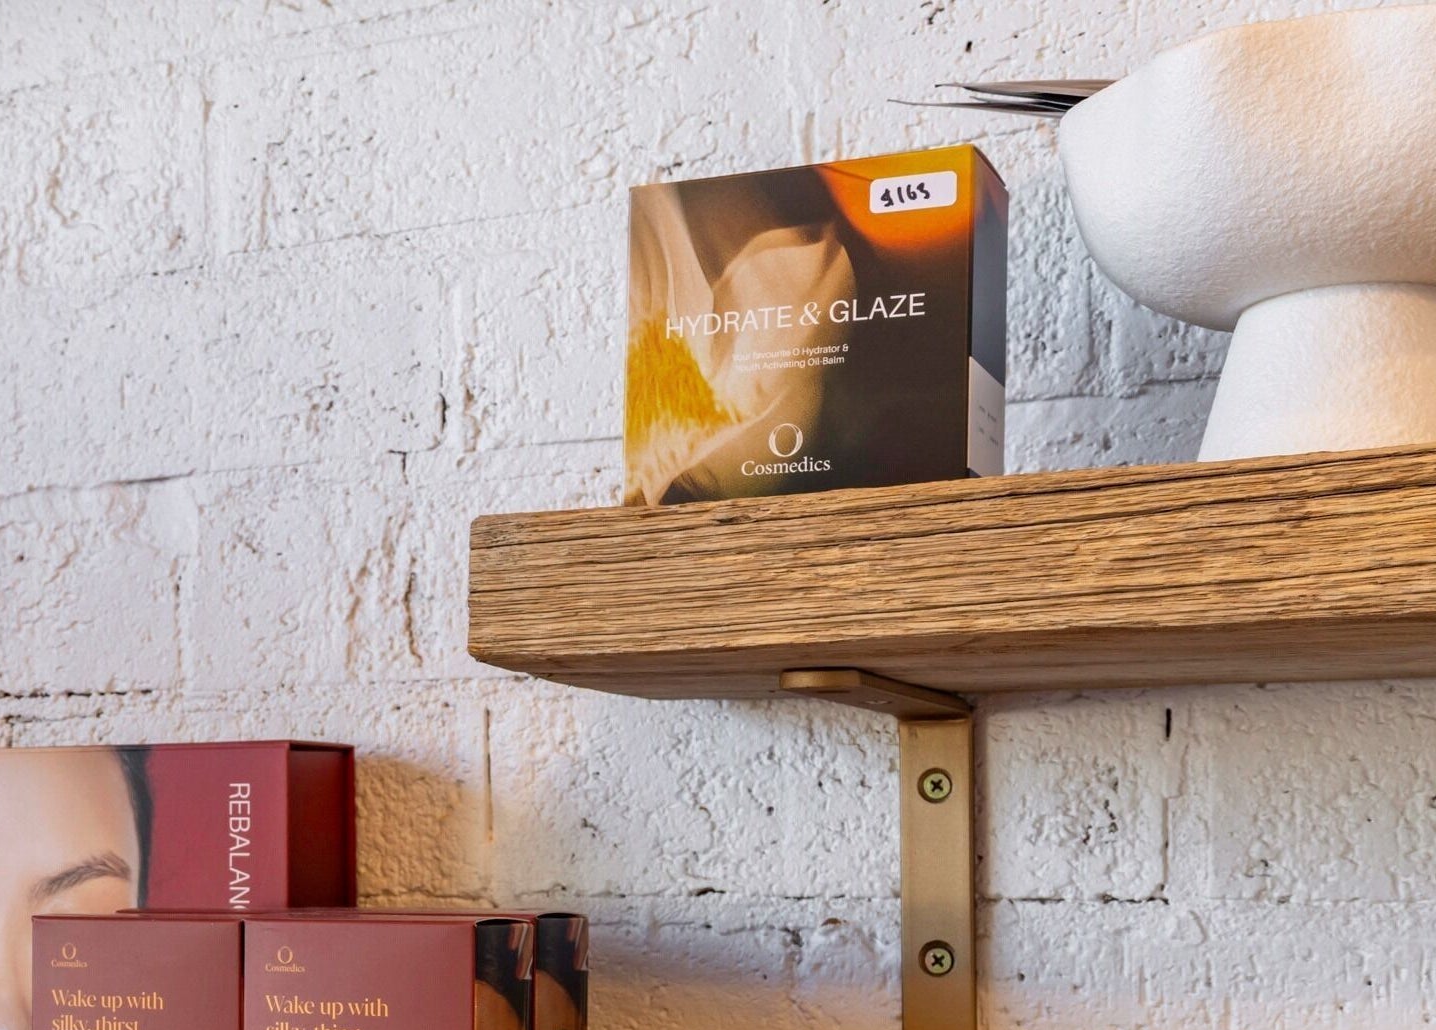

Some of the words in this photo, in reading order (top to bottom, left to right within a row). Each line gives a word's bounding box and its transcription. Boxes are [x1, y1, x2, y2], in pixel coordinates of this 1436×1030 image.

[666, 305, 793, 339] HYDRATE
[799, 301, 821, 326] &
[829, 293, 926, 323] GLAZE
[801, 345, 840, 357] Hydrator
[842, 343, 849, 352] &
[762, 360, 806, 370] Activating
[807, 356, 845, 367] Oil-Balm
[741, 456, 831, 476] Cosmedics
[229, 783, 250, 909] REBALAN
[51, 960, 88, 968] Cosmedics
[265, 963, 305, 973] Cosmedics
[52, 989, 96, 1008] Wake
[101, 994, 122, 1012] up
[127, 992, 164, 1010] with
[265, 995, 314, 1015] Wake
[320, 1000, 343, 1019] up
[348, 998, 389, 1017] with
